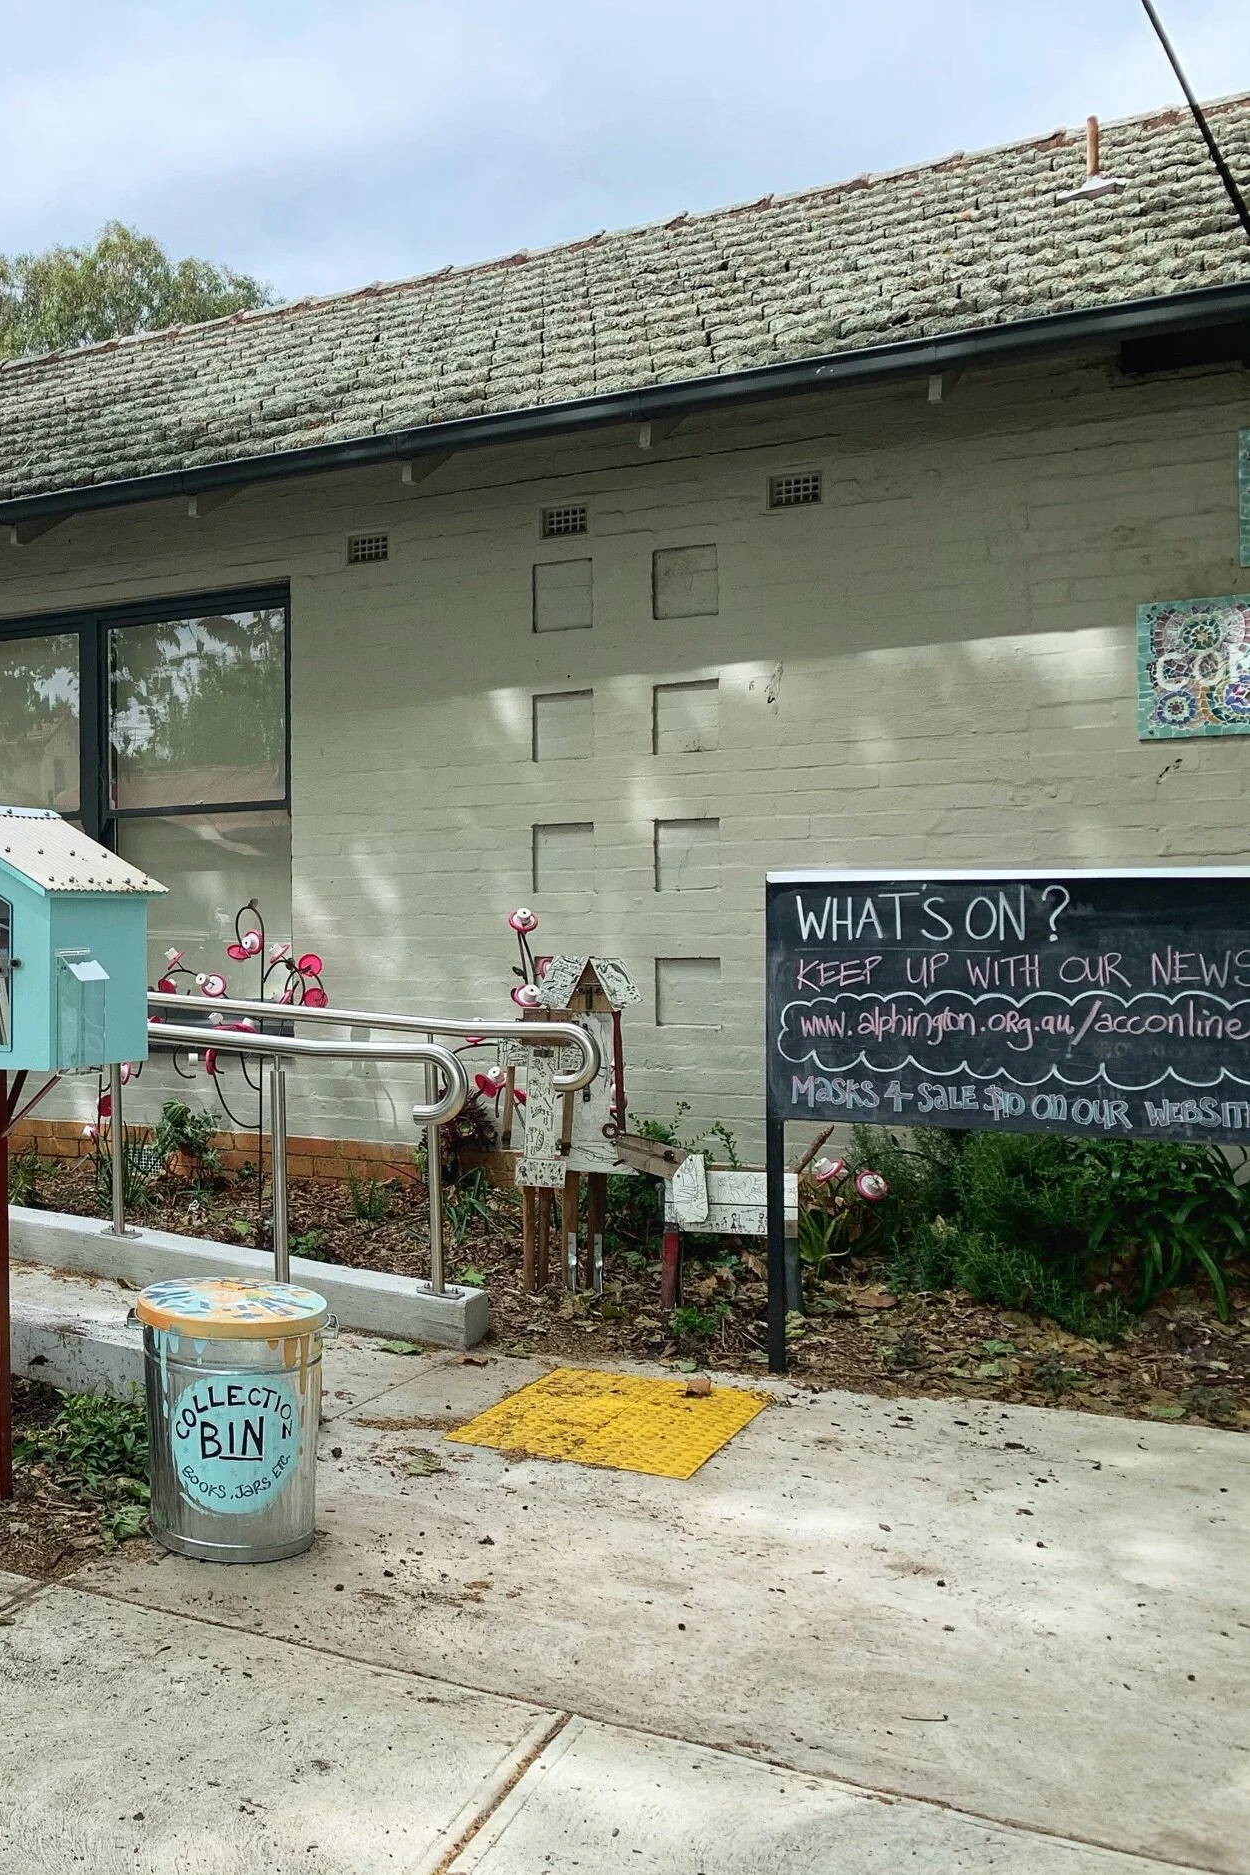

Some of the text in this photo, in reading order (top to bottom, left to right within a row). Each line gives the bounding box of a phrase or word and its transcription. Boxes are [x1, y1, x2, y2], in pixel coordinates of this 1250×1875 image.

[796, 884, 954, 942] WHAT'S
[797, 955, 883, 992] KEEP
[907, 952, 949, 988] UP
[967, 954, 1041, 989] WITH
[1059, 951, 1132, 988] OUR
[884, 1080, 914, 1113] 4
[983, 1084, 1025, 1121] $10
[1071, 1098, 1133, 1129] OUR
[1144, 1097, 1250, 1128] WEBSIT
[175, 1385, 293, 1440] COLLECTION
[200, 1415, 265, 1461] BIN
